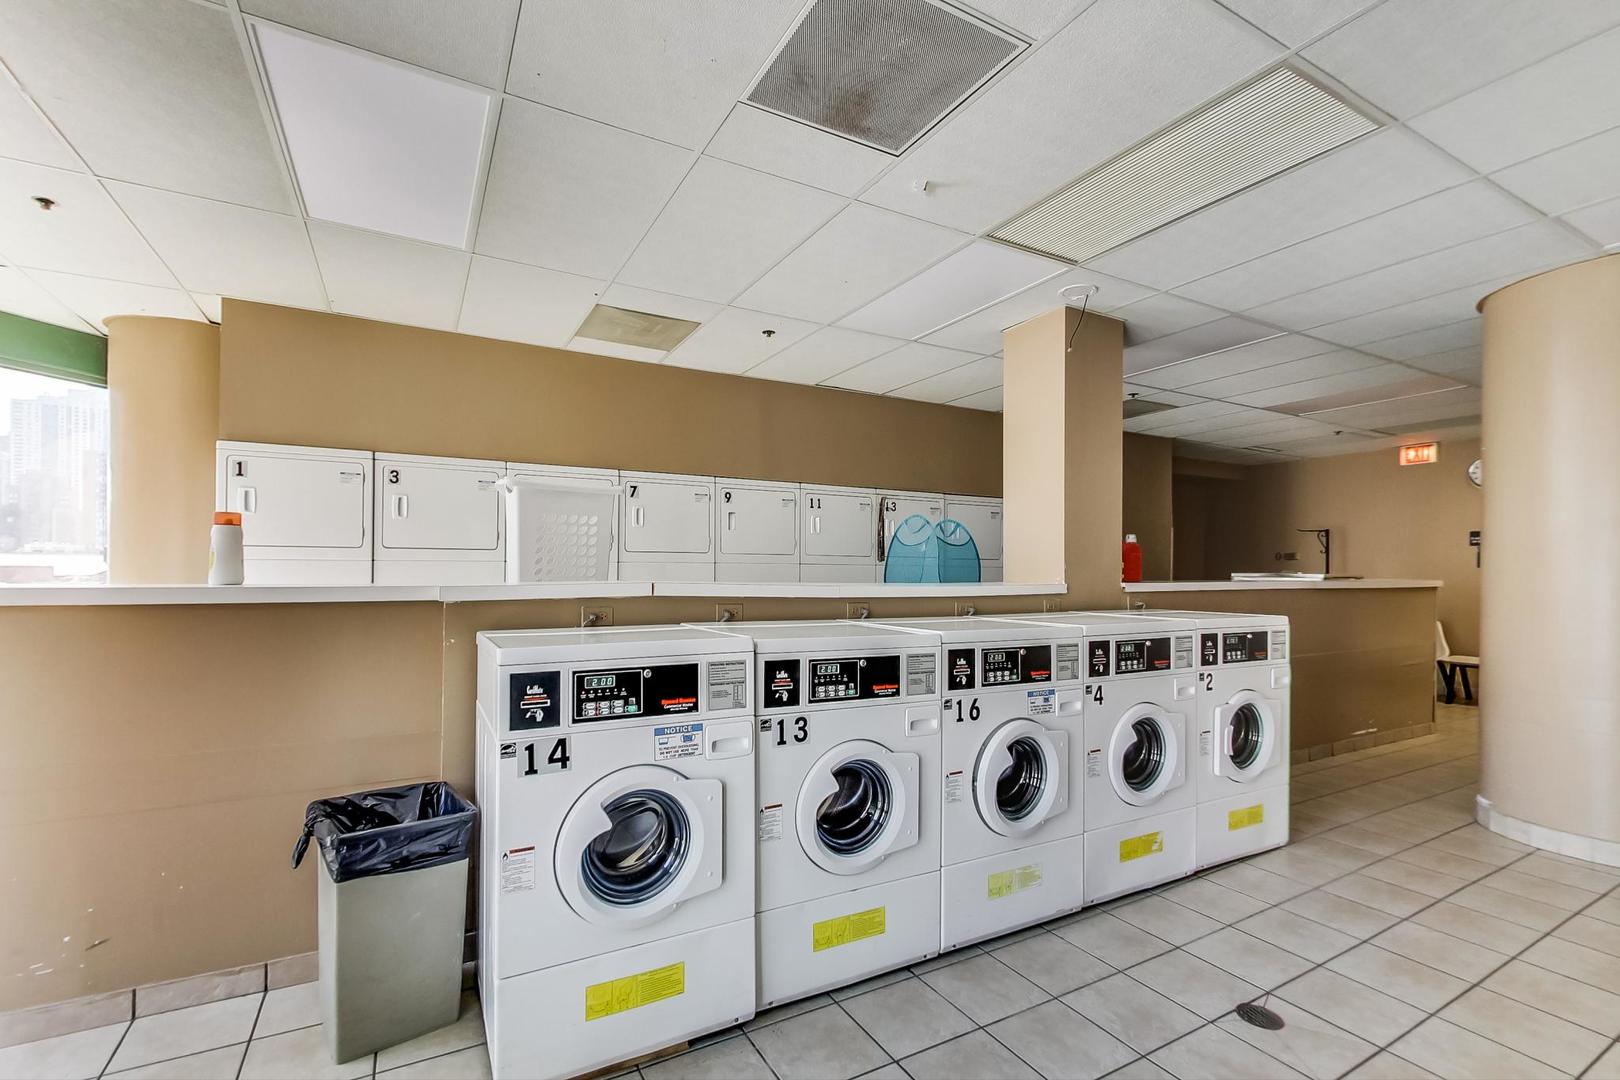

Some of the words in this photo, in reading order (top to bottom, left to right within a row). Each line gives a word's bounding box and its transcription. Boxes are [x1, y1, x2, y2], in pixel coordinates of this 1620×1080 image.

[1406, 445, 1434, 463] EXIT
[236, 461, 245, 477] 1
[389, 469, 400, 484] 3
[629, 485, 639, 499] 7
[724, 491, 733, 504] 9
[809, 497, 823, 510] 11
[1206, 673, 1214, 692] 2
[1093, 685, 1104, 706] 4
[956, 697, 981, 724] 16
[664, 725, 693, 734] NOTICE
[777, 717, 808, 746] 13
[524, 737, 570, 776] 14
